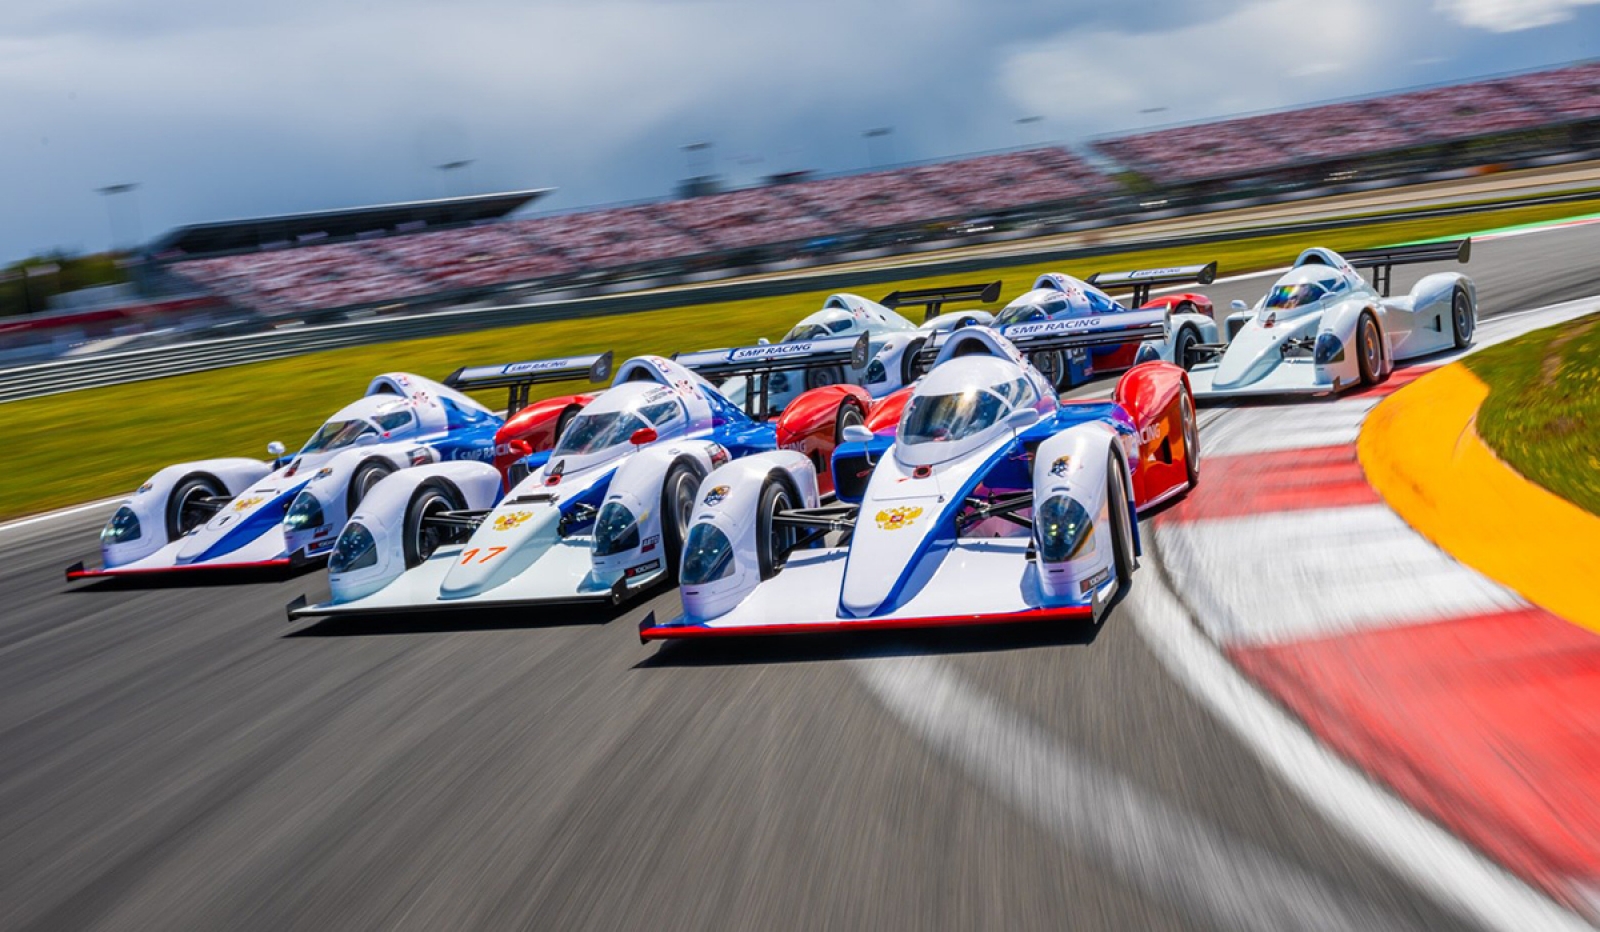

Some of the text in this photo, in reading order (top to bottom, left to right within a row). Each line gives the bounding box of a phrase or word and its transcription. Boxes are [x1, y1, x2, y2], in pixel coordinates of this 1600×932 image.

[1011, 318, 1100, 336] SMP RACING
[738, 343, 812, 358] SMP RACING
[460, 449, 481, 461] SMP
[461, 546, 508, 565] 17
